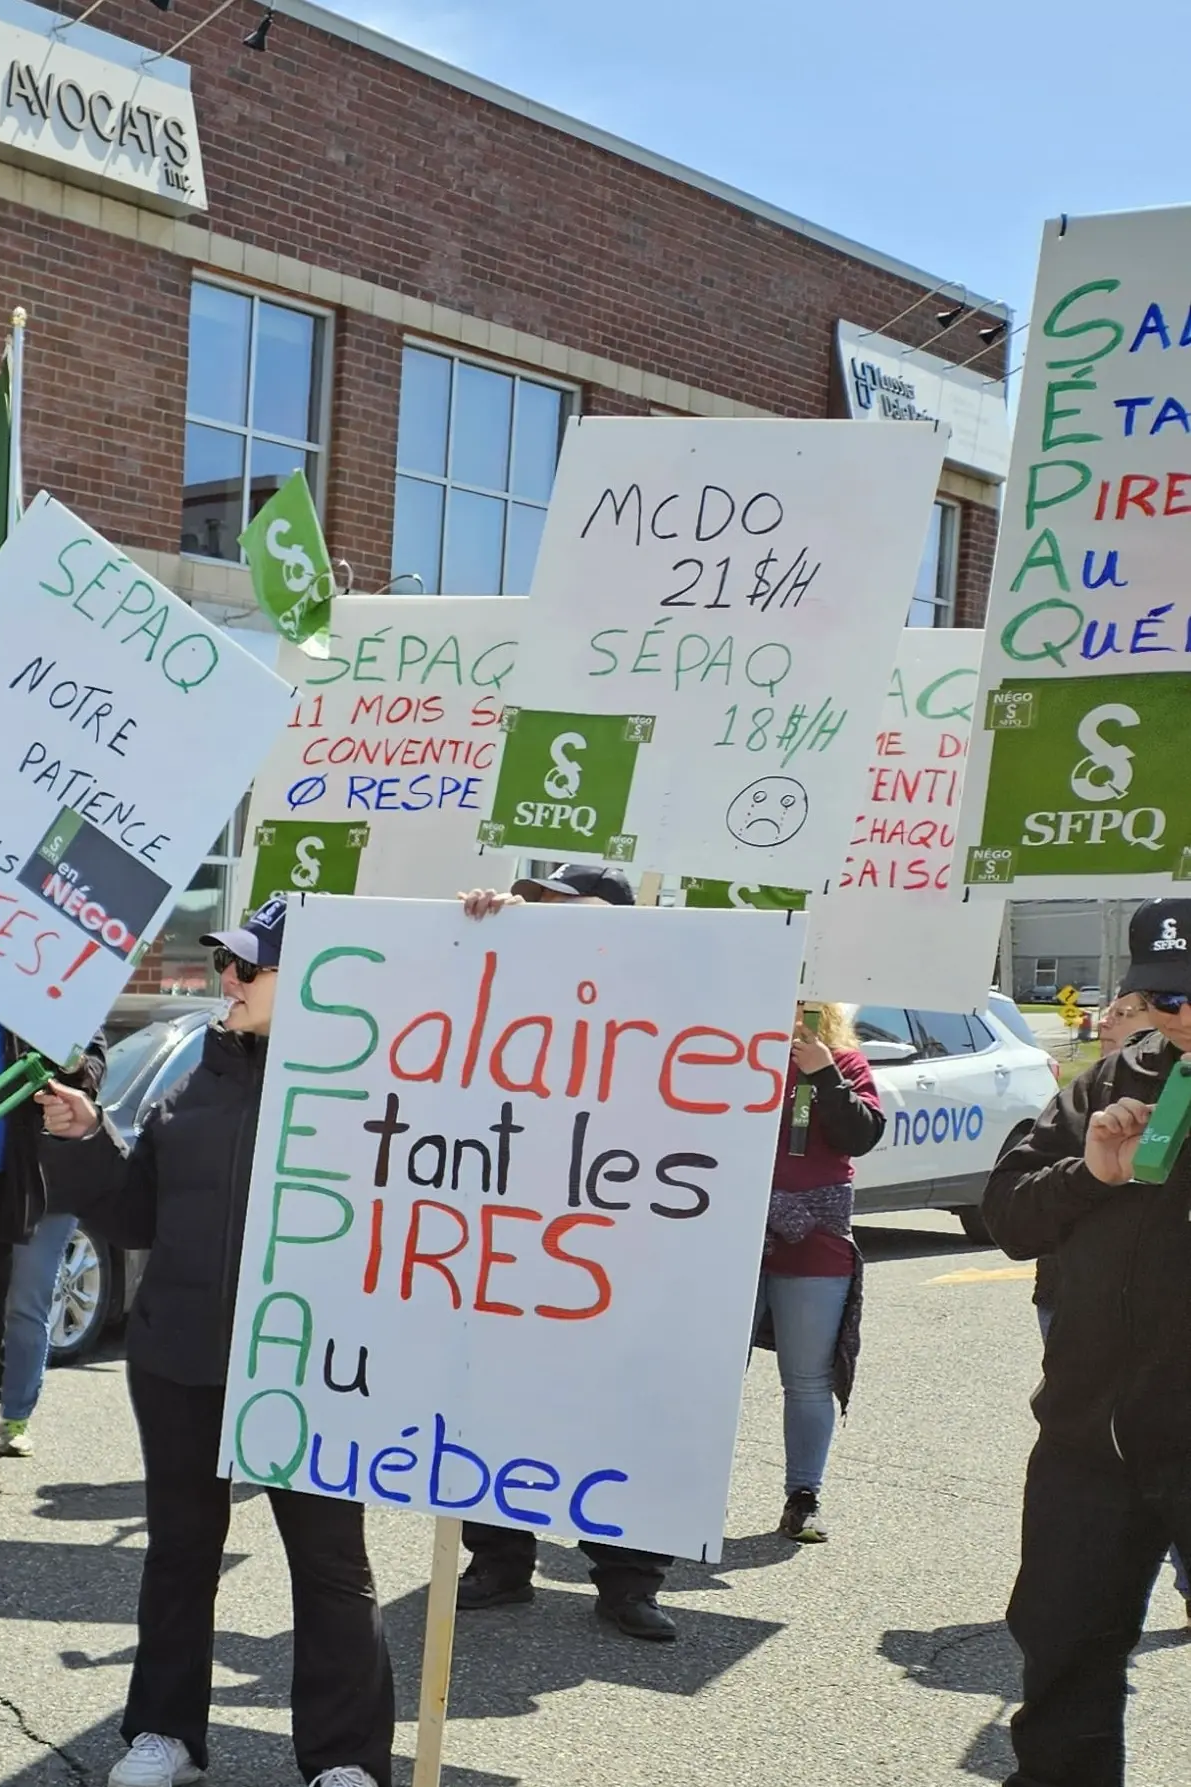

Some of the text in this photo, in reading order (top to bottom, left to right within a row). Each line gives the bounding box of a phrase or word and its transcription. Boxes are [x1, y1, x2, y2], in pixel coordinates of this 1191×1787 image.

[7, 59, 190, 167] AVOCATS
[164, 163, 196, 194] inc.
[39, 537, 220, 694] SÉPAQ
[589, 617, 792, 698] SÉPAQ
[8, 656, 138, 757] NOTRE
[351, 695, 445, 727] MOIS
[994, 690, 1033, 703] NÉGO
[347, 774, 485, 811] RESPE
[513, 801, 597, 837] SFPQ
[1021, 807, 1167, 851] SFPQ
[58, 861, 79, 883] en
[974, 848, 1012, 859] NÉGO
[42, 872, 128, 947] NÉGO
[1153, 938, 1187, 951] SFPQ
[893, 1105, 983, 1146] noovo
[567, 1110, 718, 1219] les
[261, 1180, 615, 1320] PIRES
[234, 1388, 629, 1537] Québec
